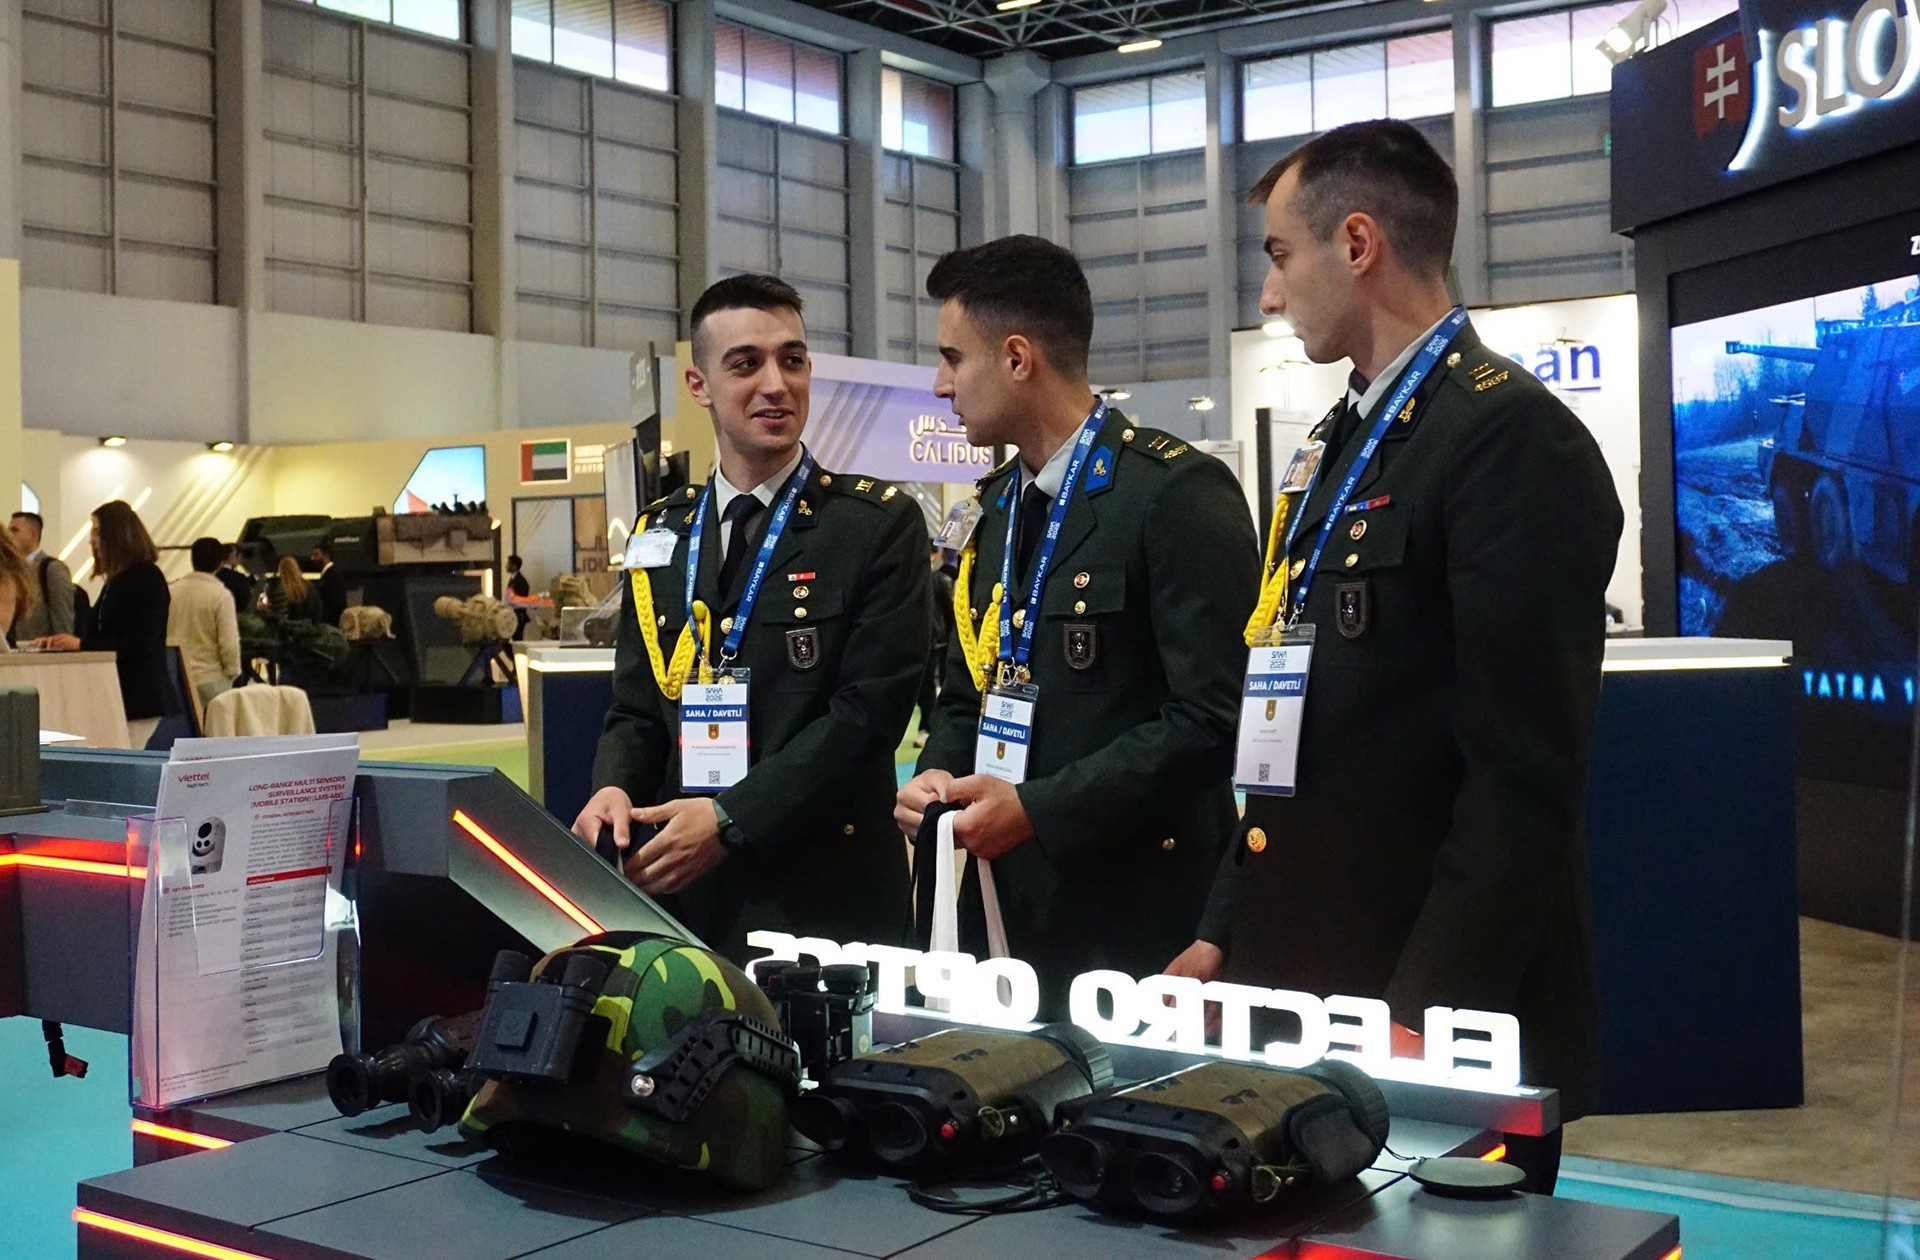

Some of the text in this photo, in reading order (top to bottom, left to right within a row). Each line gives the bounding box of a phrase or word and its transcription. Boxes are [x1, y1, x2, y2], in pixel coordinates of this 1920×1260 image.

[1388, 370, 1421, 414] BAYKAR
[910, 441, 992, 465] CALIDUS
[1061, 460, 1079, 498] BAYKAR
[777, 493, 795, 521] BAYKAR
[1329, 476, 1355, 524] BAYKAR
[746, 568, 762, 602] BAYKAR
[1032, 556, 1047, 596] BAYKAR
[1271, 651, 1287, 659] SAHA
[1249, 680, 1267, 690] SAHA
[1273, 678, 1301, 690] DAVETLİ
[1803, 669, 1886, 703] TATRA
[686, 710, 706, 718] SAHA
[712, 708, 742, 718] DAVETLİ
[982, 723, 998, 734] SAHA
[1002, 726, 1026, 739] DAVETLİ
[178, 773, 210, 783] viettel
[249, 780, 294, 792] LONG-RANGE
[316, 775, 346, 785] SENSORS
[268, 784, 345, 798] SURVEILLANCE SYSTEM
[251, 799, 279, 809] (MOBILE
